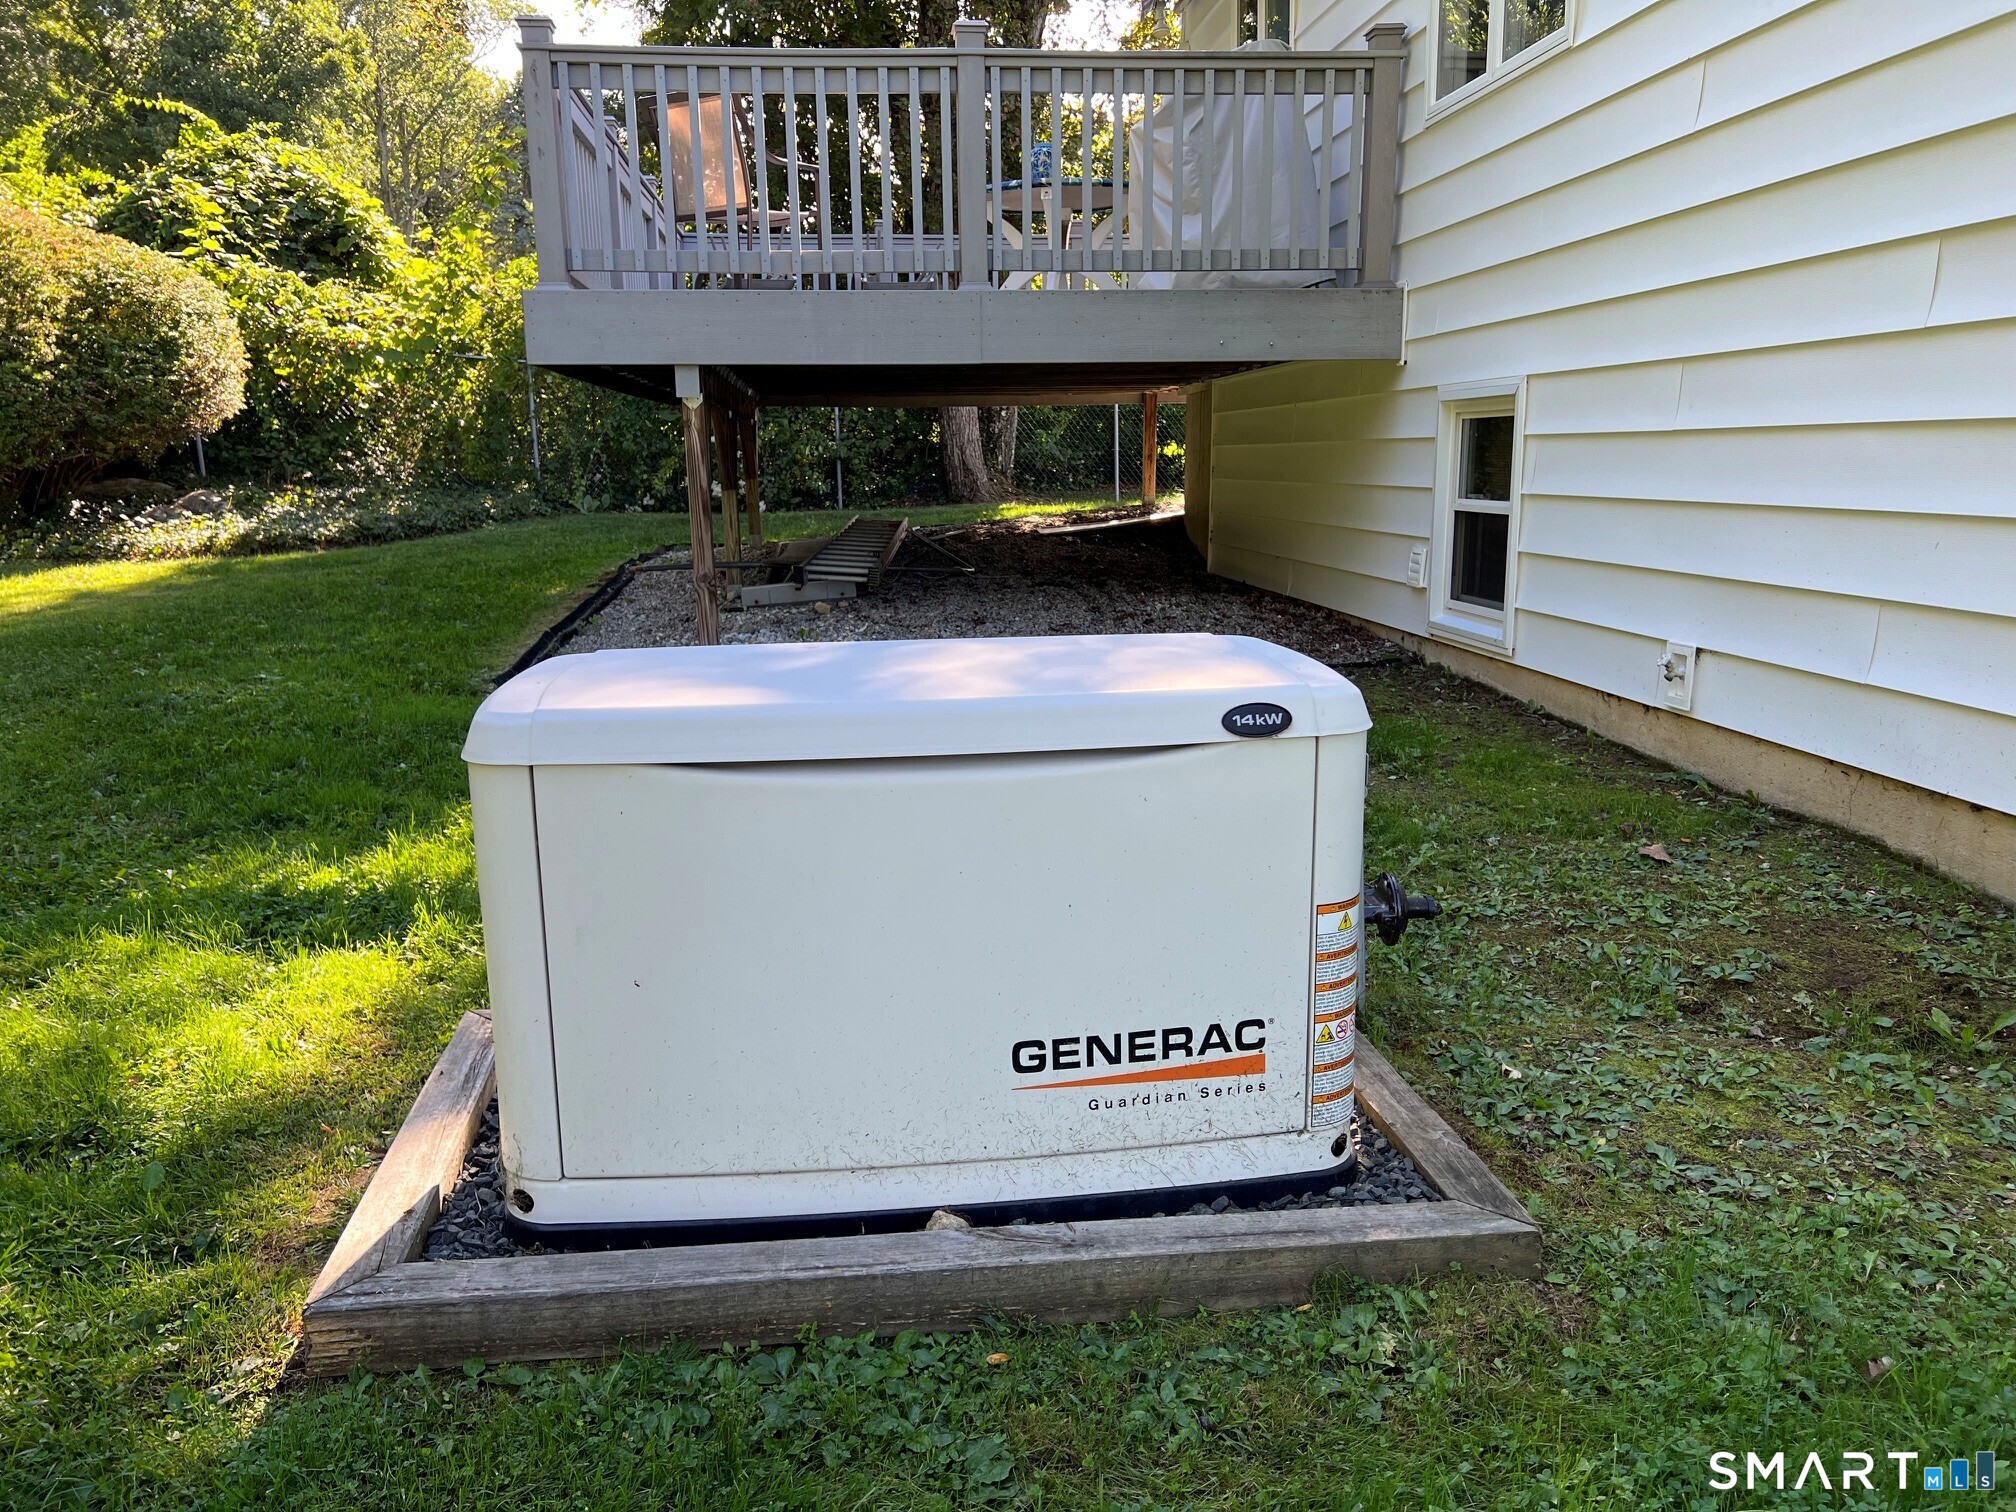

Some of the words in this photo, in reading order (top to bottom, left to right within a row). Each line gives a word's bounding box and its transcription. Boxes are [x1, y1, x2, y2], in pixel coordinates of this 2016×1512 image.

[1232, 712, 1283, 727] 14kW
[1011, 1018, 1266, 1074] GENERAC
[1088, 1091, 1186, 1111] Guardian
[1200, 1082, 1266, 1099] Series
